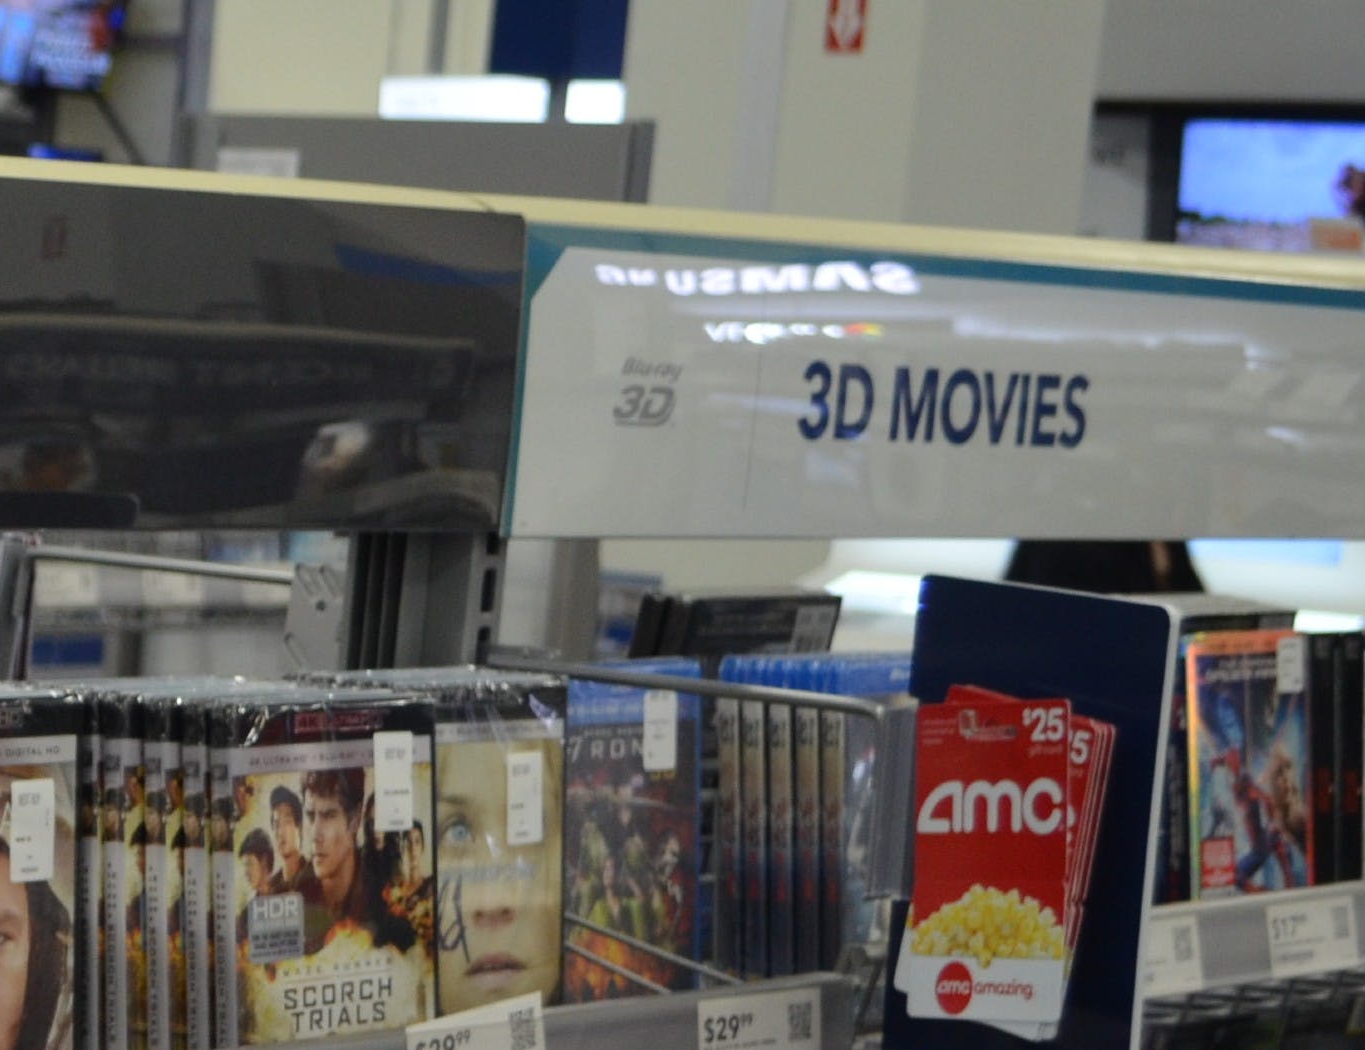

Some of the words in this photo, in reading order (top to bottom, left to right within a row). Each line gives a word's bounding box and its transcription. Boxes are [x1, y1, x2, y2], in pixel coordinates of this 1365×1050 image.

[797, 360, 875, 442] 3D
[888, 366, 1091, 450] MOVIES
[1022, 706, 1066, 743] $25
[252, 897, 300, 921] HDR
[283, 976, 393, 1011] SCORCH
[292, 1001, 386, 1033] TRIALS
